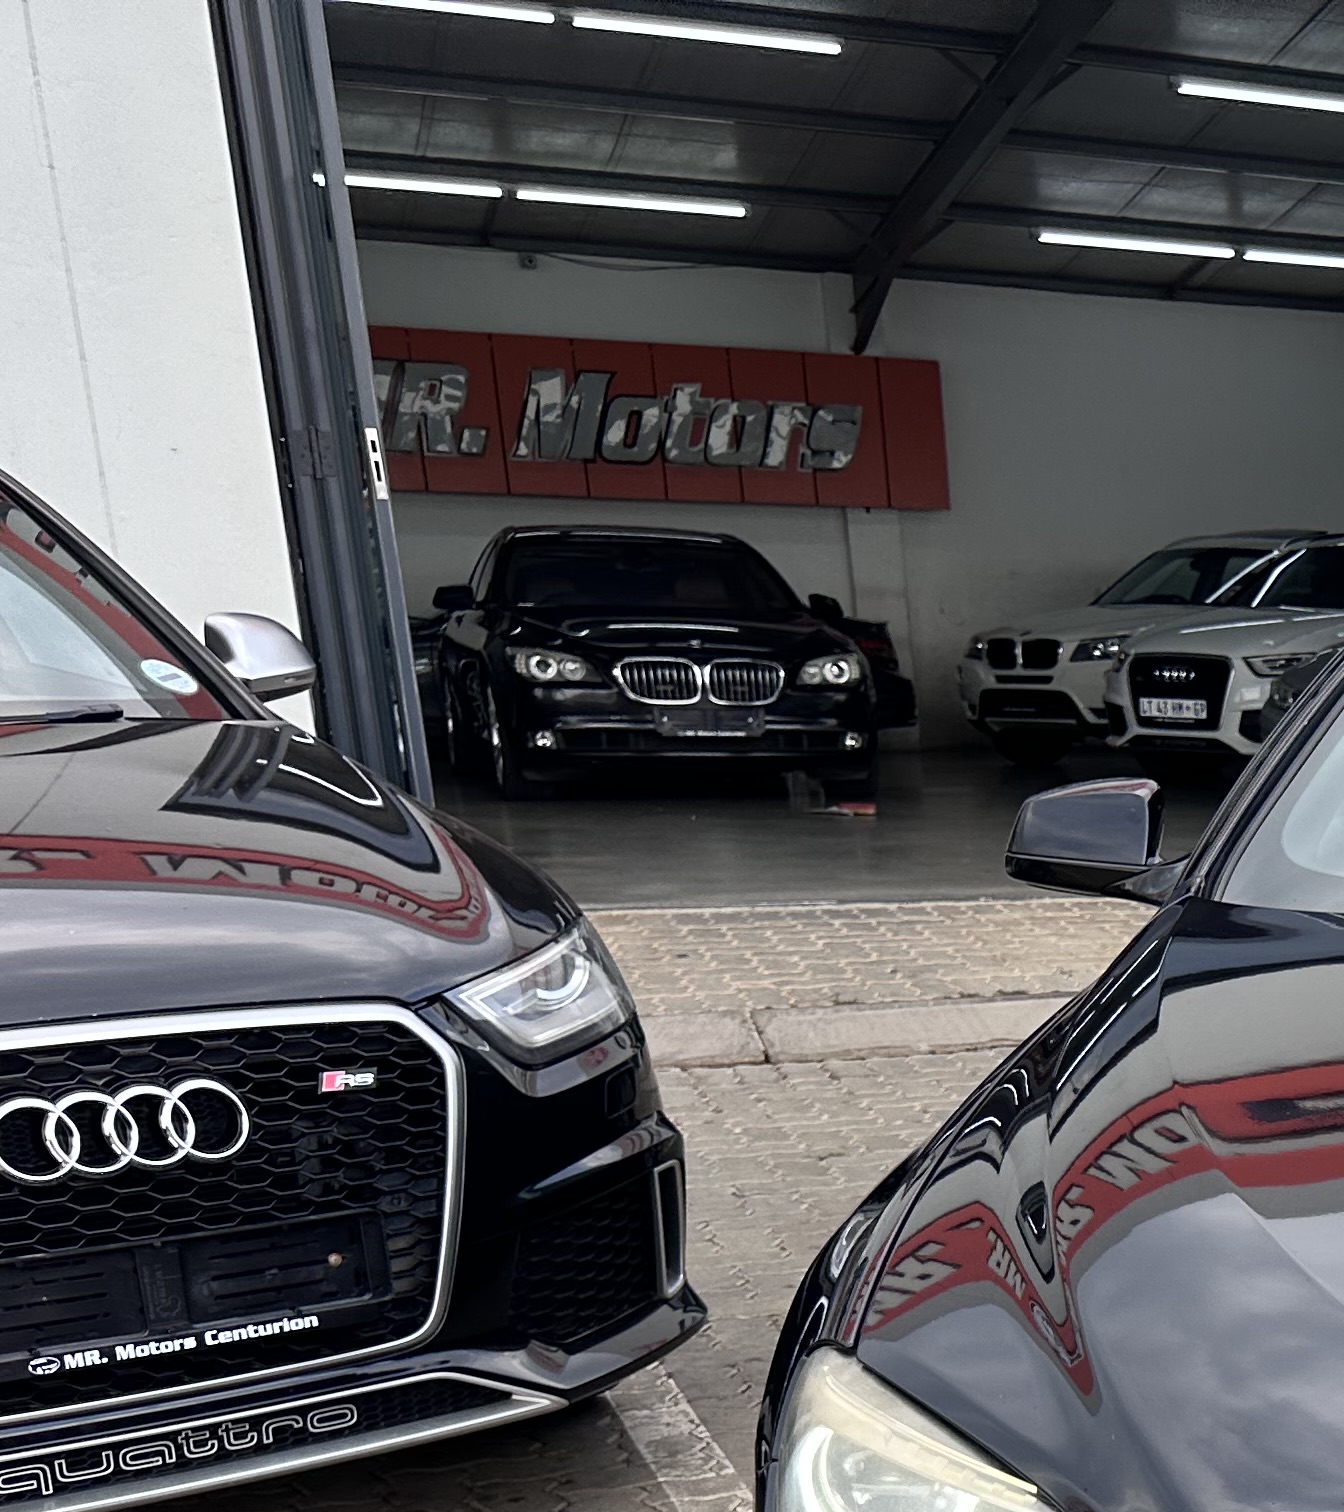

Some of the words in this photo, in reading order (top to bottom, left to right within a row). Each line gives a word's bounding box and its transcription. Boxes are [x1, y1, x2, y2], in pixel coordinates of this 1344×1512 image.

[511, 367, 862, 473] Motors
[334, 1073, 374, 1087] RS
[64, 1349, 109, 1370] MR.
[115, 1336, 197, 1361] Motors
[205, 1315, 319, 1346] Centurion
[0, 1404, 357, 1495] quattro
